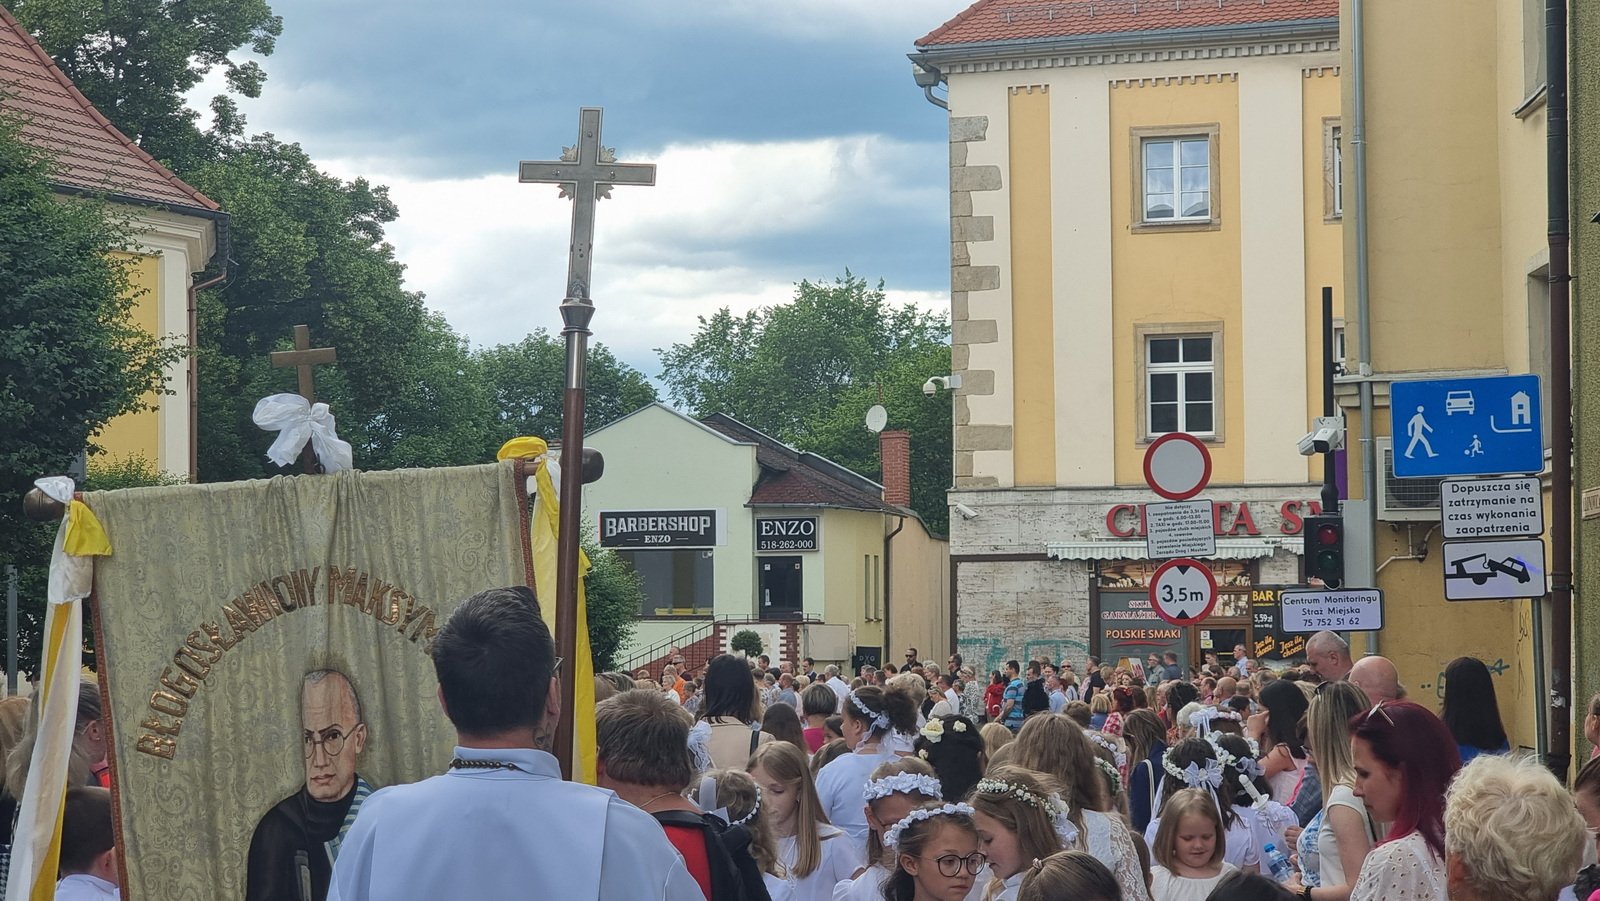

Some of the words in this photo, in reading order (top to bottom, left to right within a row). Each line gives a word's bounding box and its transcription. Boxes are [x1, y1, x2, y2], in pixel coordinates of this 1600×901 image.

[1452, 483, 1510, 495] Dopuszcza
[1515, 481, 1530, 492] się
[1448, 495, 1516, 508] zatrzymanie
[1476, 508, 1536, 521] wykonania
[605, 516, 711, 537] BARBERSHOP
[761, 520, 814, 536] ENZO
[1456, 522, 1530, 536] zaopatrzenia
[644, 535, 671, 543] ENZO
[761, 540, 813, 549] 518-262-000
[1252, 590, 1274, 601] BAR
[1324, 595, 1377, 604] Monitoringu
[1328, 607, 1360, 616] Miejska
[1106, 630, 1146, 639] POLSKIE
[1148, 629, 1181, 638] SMAKI
[1280, 640, 1294, 654] Jesz
[136, 566, 320, 760] BŁOGOSŁAWIONY
